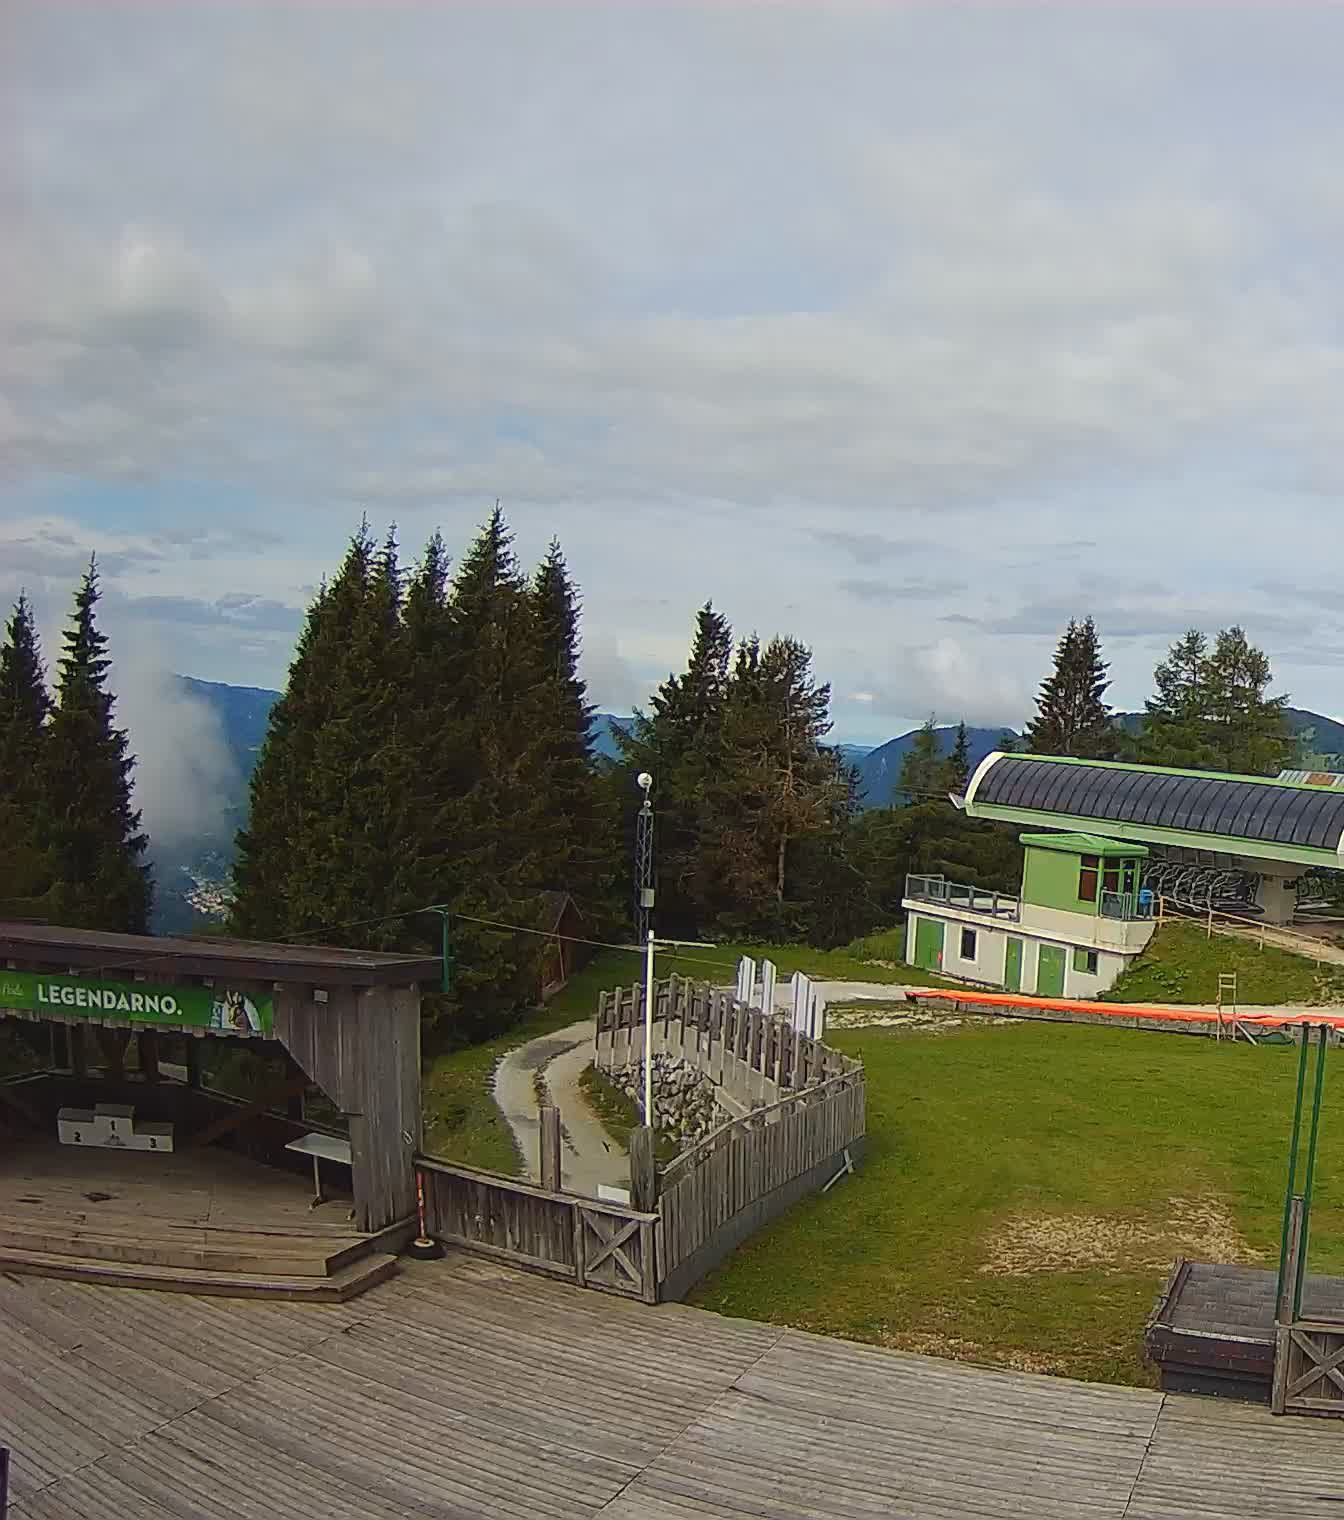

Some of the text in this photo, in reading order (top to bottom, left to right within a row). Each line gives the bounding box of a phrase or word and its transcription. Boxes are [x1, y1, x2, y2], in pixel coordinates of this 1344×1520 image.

[37, 984, 183, 1016] LEGENDARNO.
[109, 1120, 116, 1131] 1
[74, 1131, 81, 1142] 2
[149, 1137, 157, 1149] 3
